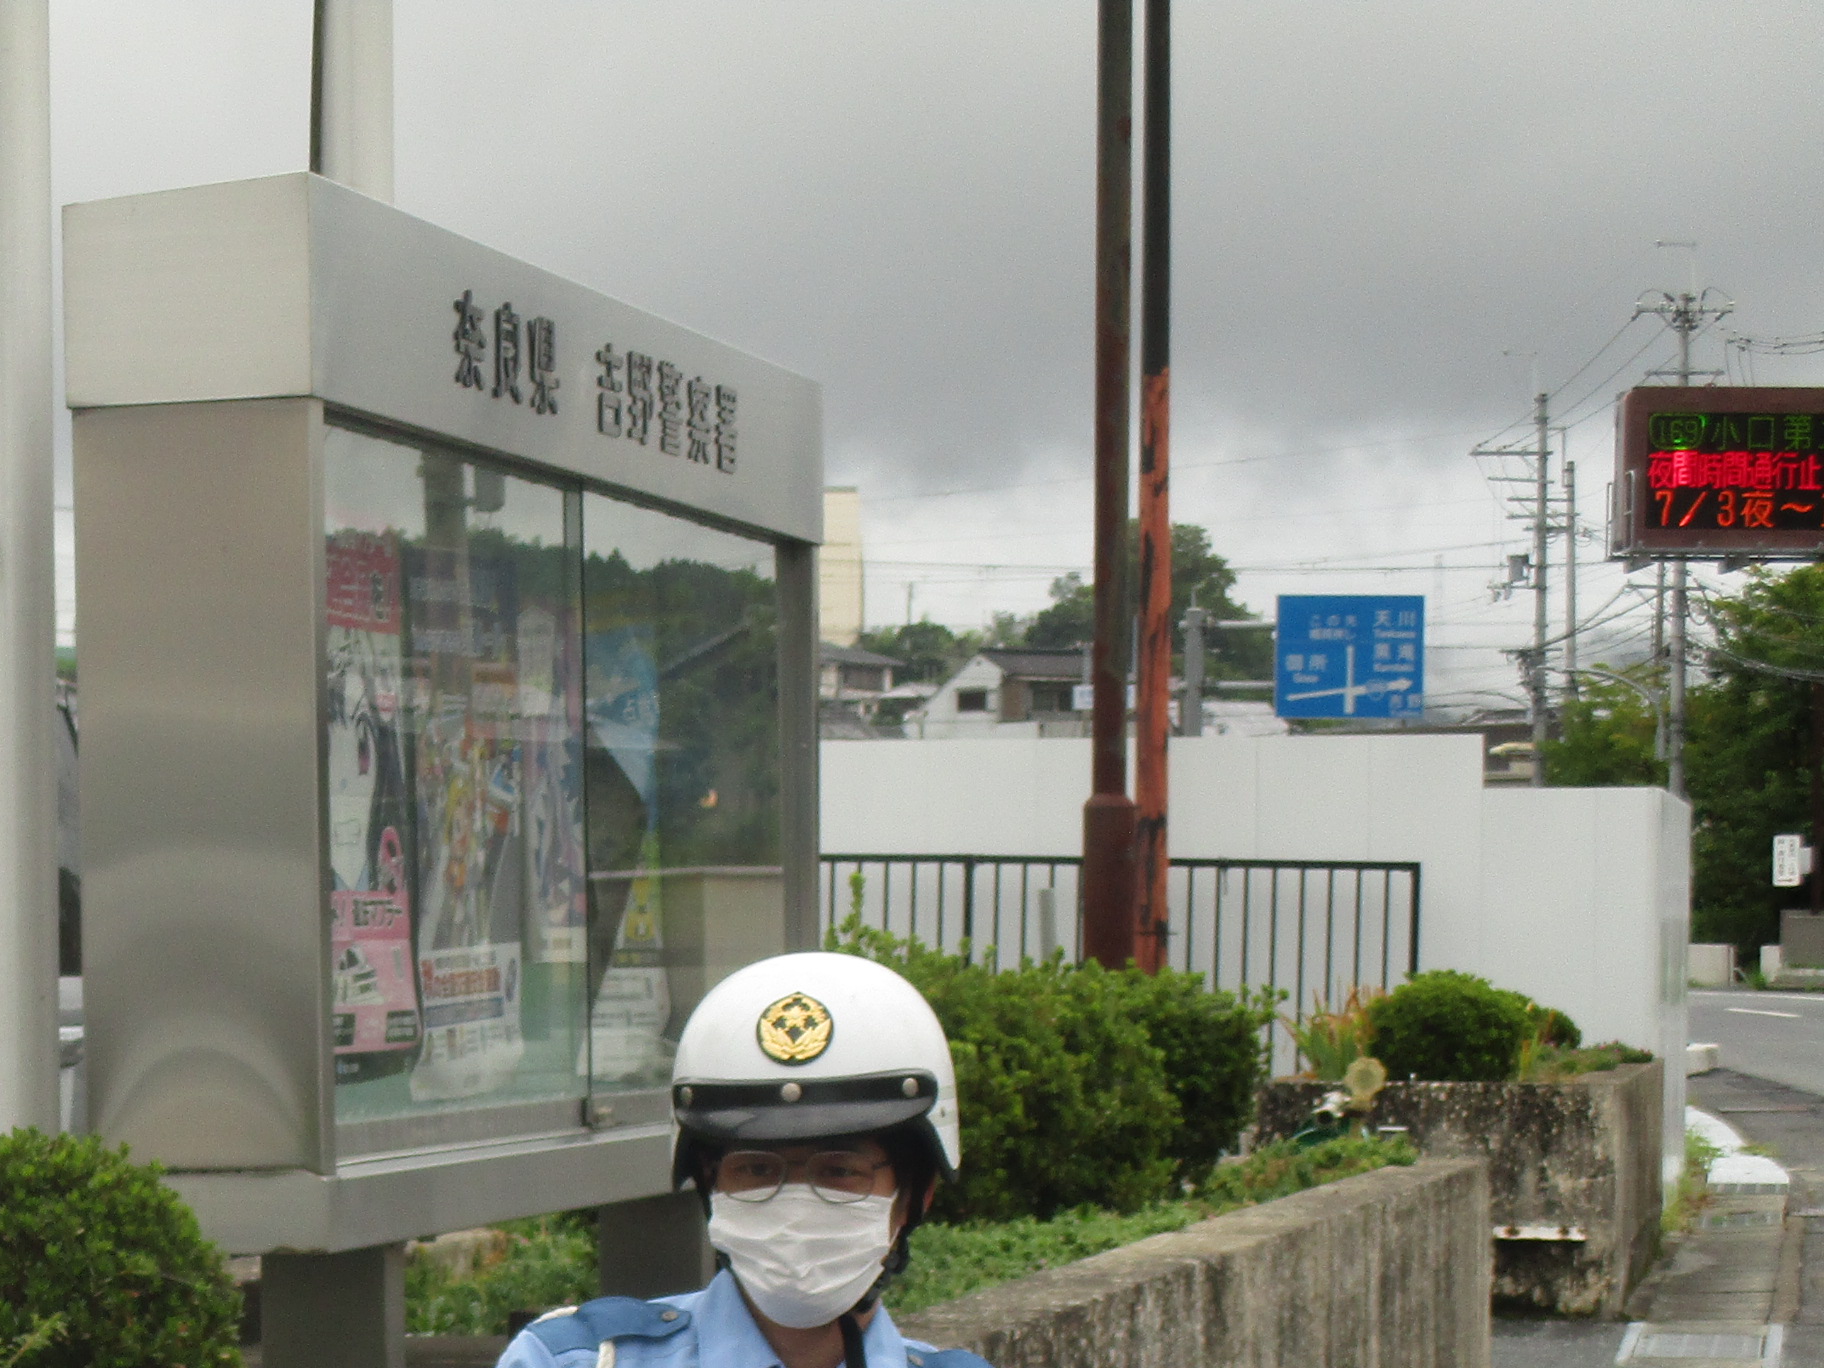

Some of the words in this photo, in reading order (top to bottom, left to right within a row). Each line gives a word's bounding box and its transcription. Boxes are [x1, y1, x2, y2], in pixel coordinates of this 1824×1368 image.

[453, 289, 560, 416] 奈良県
[595, 342, 738, 475] 吉野警察署
[1711, 415, 1824, 450] 小口第
